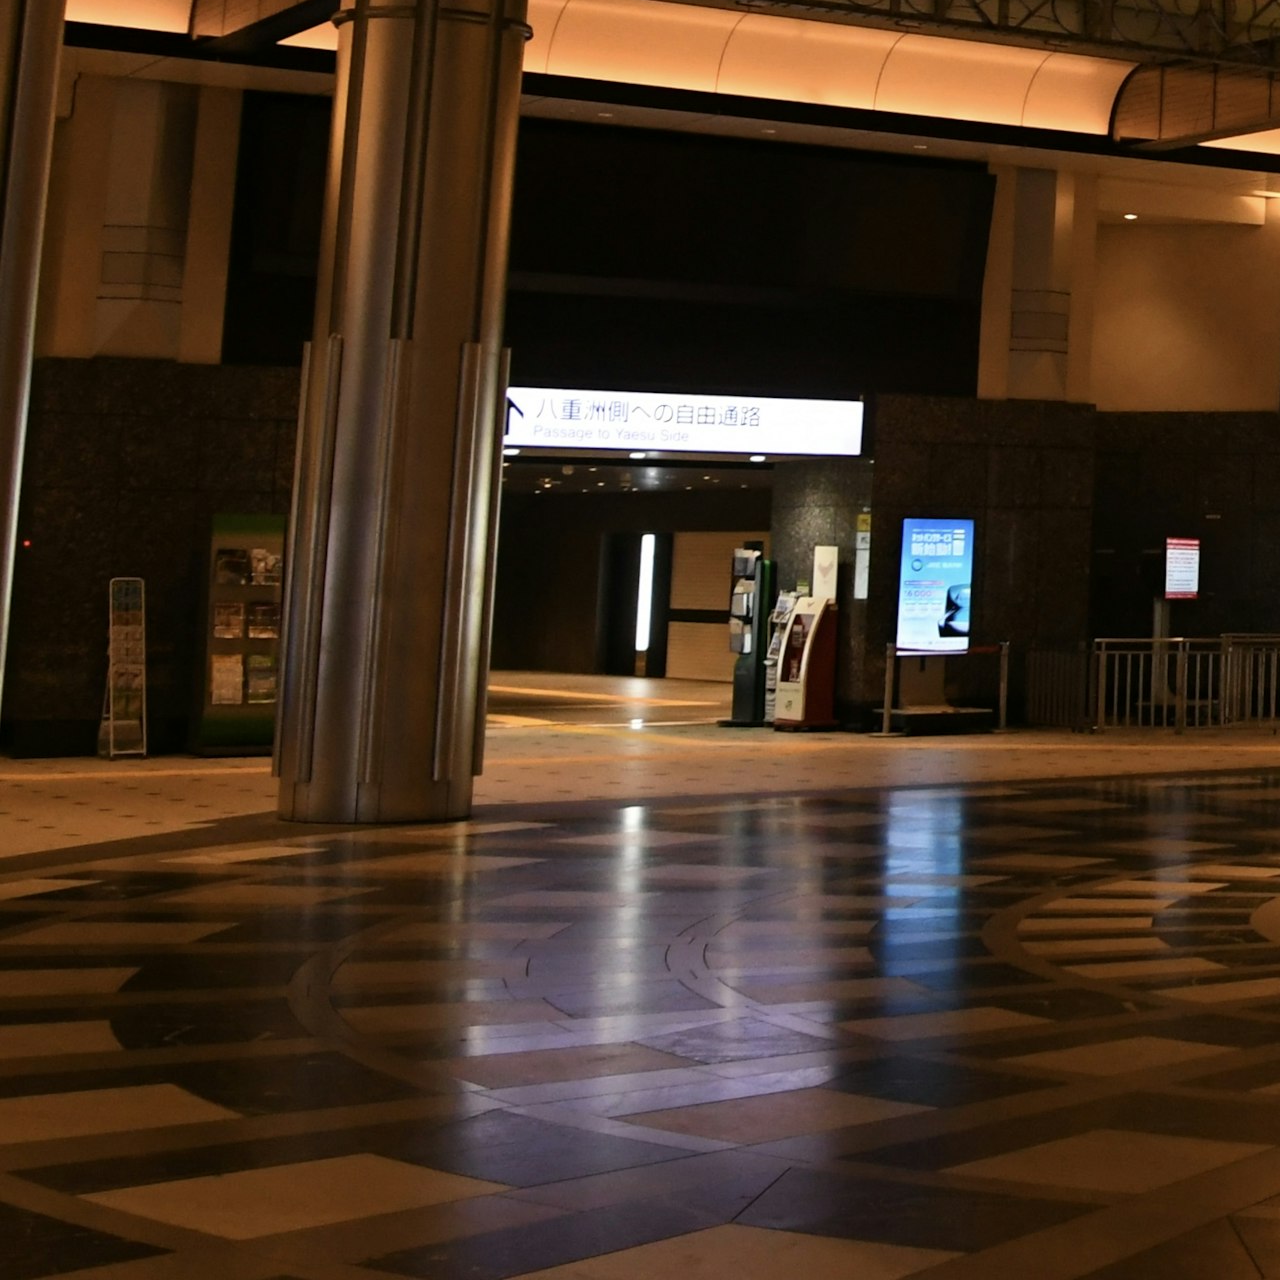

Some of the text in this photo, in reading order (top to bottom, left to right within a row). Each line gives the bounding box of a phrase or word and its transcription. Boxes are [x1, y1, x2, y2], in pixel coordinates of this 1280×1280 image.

[536, 398, 760, 428] 八重洲側への自由通路
[534, 424, 690, 442] Passage to Yaesu Side
